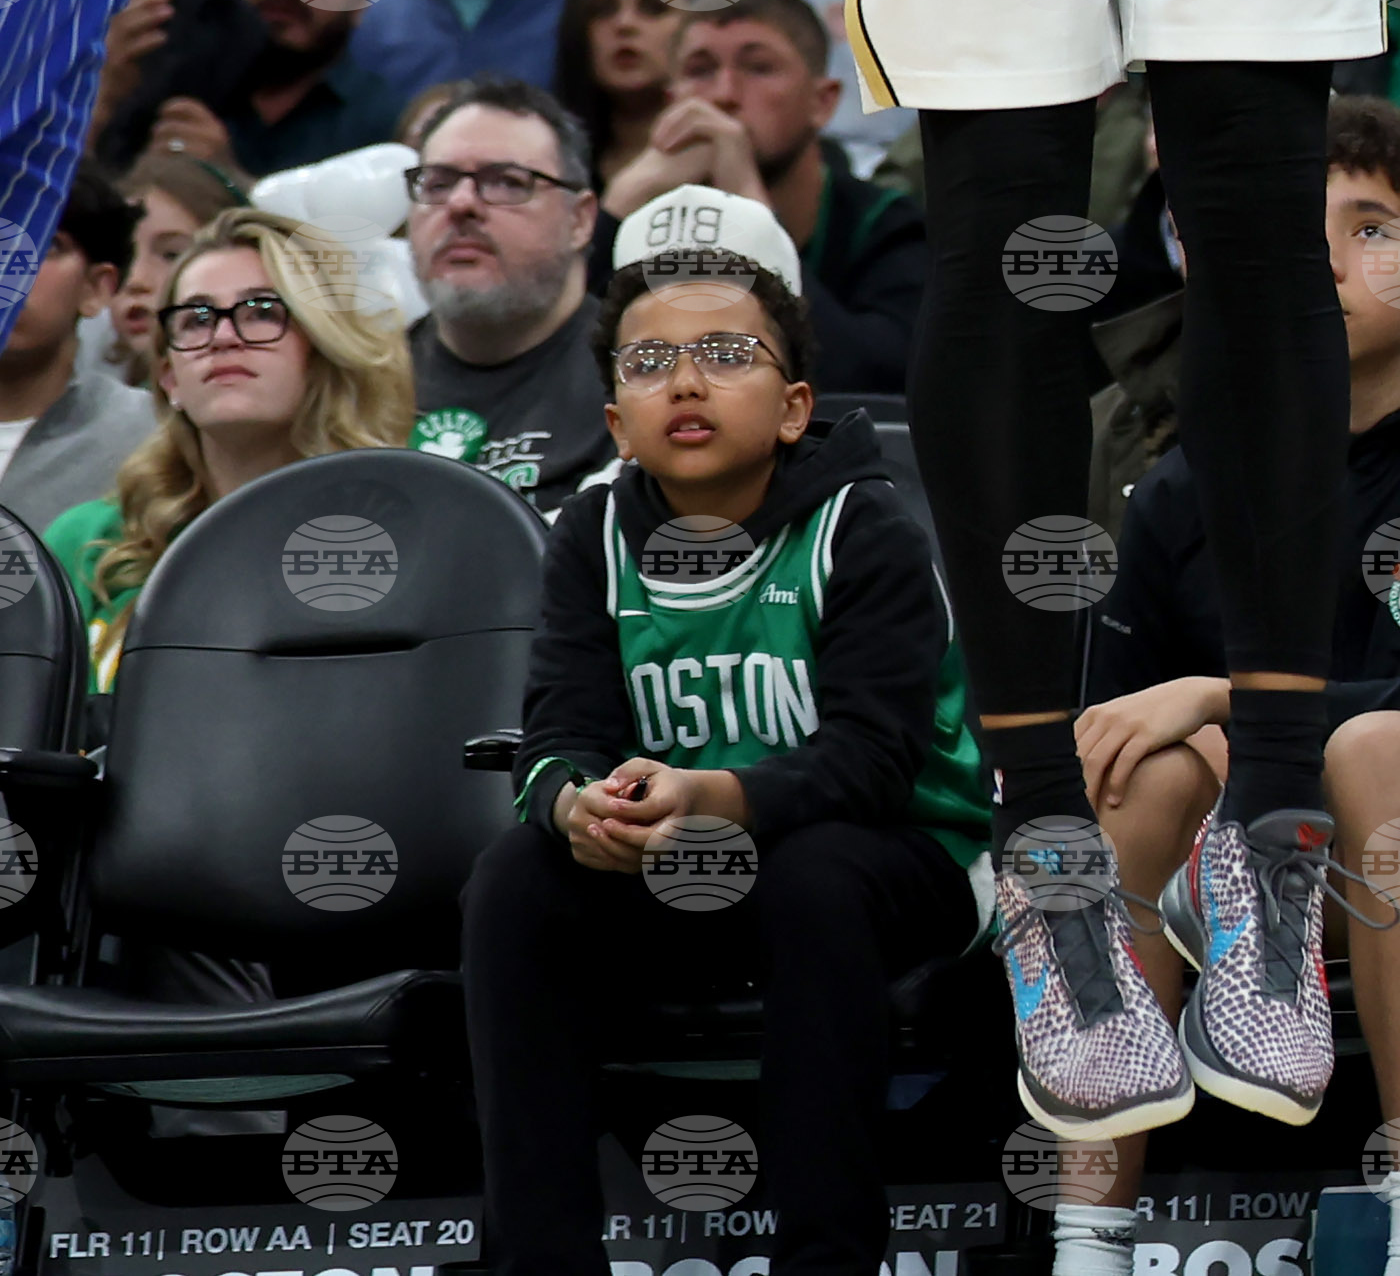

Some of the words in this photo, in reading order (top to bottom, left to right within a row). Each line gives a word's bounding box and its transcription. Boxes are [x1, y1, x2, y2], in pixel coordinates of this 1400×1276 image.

[627, 652, 820, 752] OSTON
[704, 1209, 780, 1237] ROW
[889, 1202, 956, 1231] EAT
[964, 1202, 998, 1229] 21
[1229, 1192, 1310, 1219] ROW
[50, 1233, 109, 1258] FLR
[181, 1227, 260, 1254] ROW
[266, 1225, 311, 1251] AA
[348, 1220, 430, 1248] SEAT
[437, 1219, 475, 1245] 20
